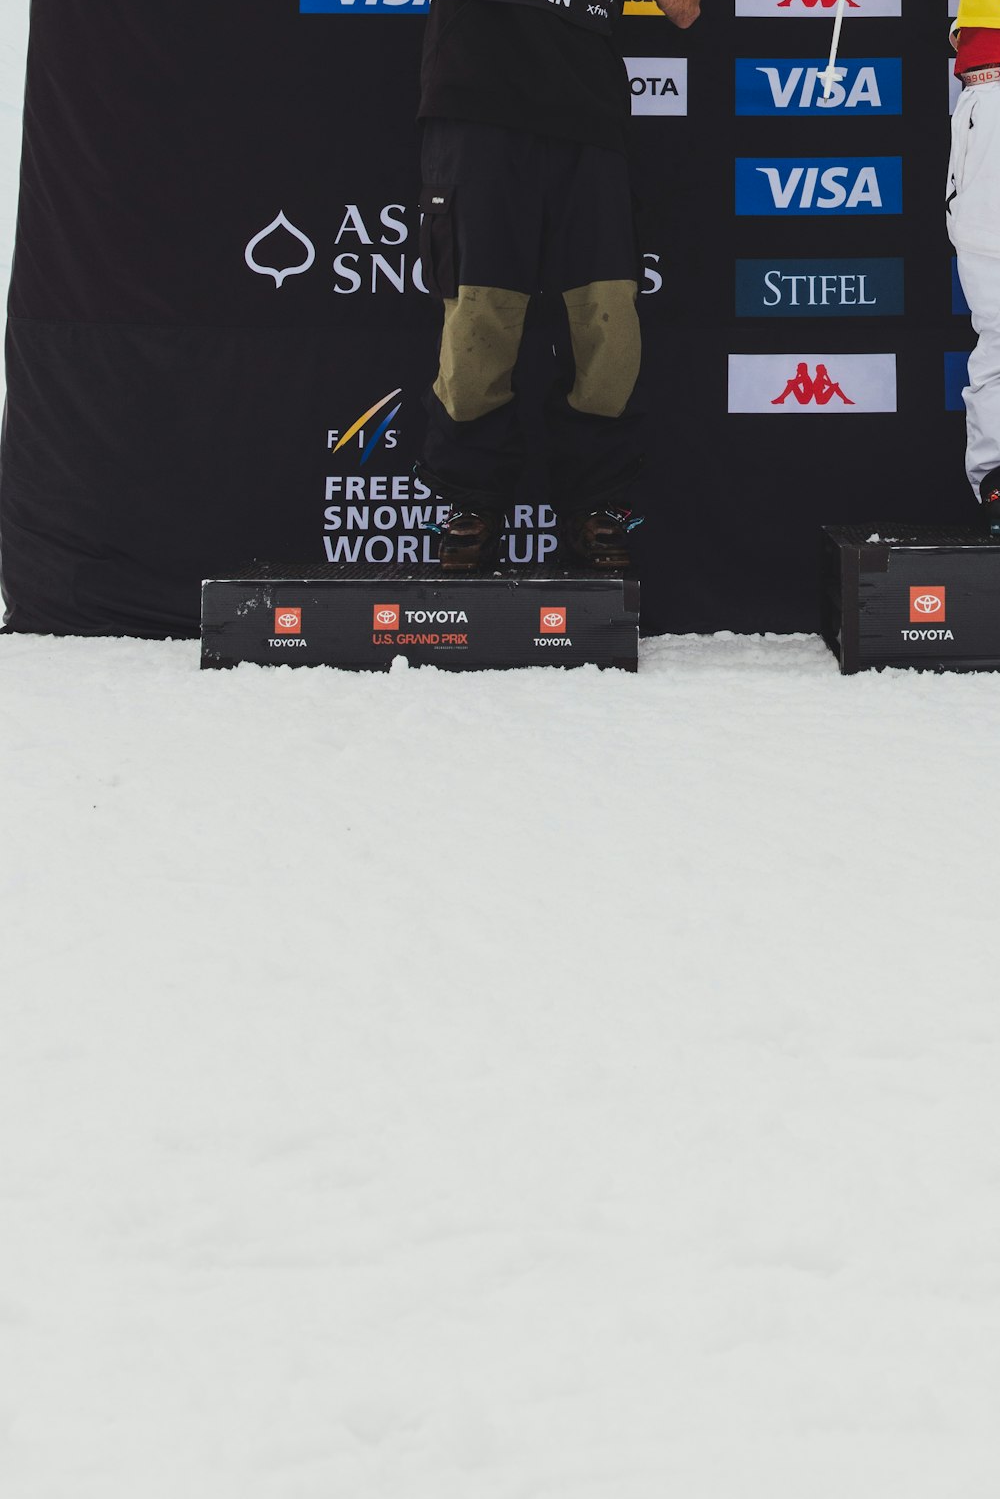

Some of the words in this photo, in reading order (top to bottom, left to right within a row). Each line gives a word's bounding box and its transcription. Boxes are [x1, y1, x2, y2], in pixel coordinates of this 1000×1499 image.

[629, 76, 679, 96] OTA
[755, 66, 882, 108] VISA
[755, 166, 883, 209] VISA
[762, 270, 877, 307] STIFEL
[325, 476, 443, 500] FREES
[323, 535, 441, 563] WORL
[404, 610, 469, 623] TOYOTA
[268, 638, 307, 648] TOYOTA
[372, 633, 394, 645] U.S.
[396, 633, 440, 645] GRAND
[441, 633, 468, 644] PRIX
[533, 638, 573, 647] TOYOTA
[901, 629, 954, 640] TOYOTA
